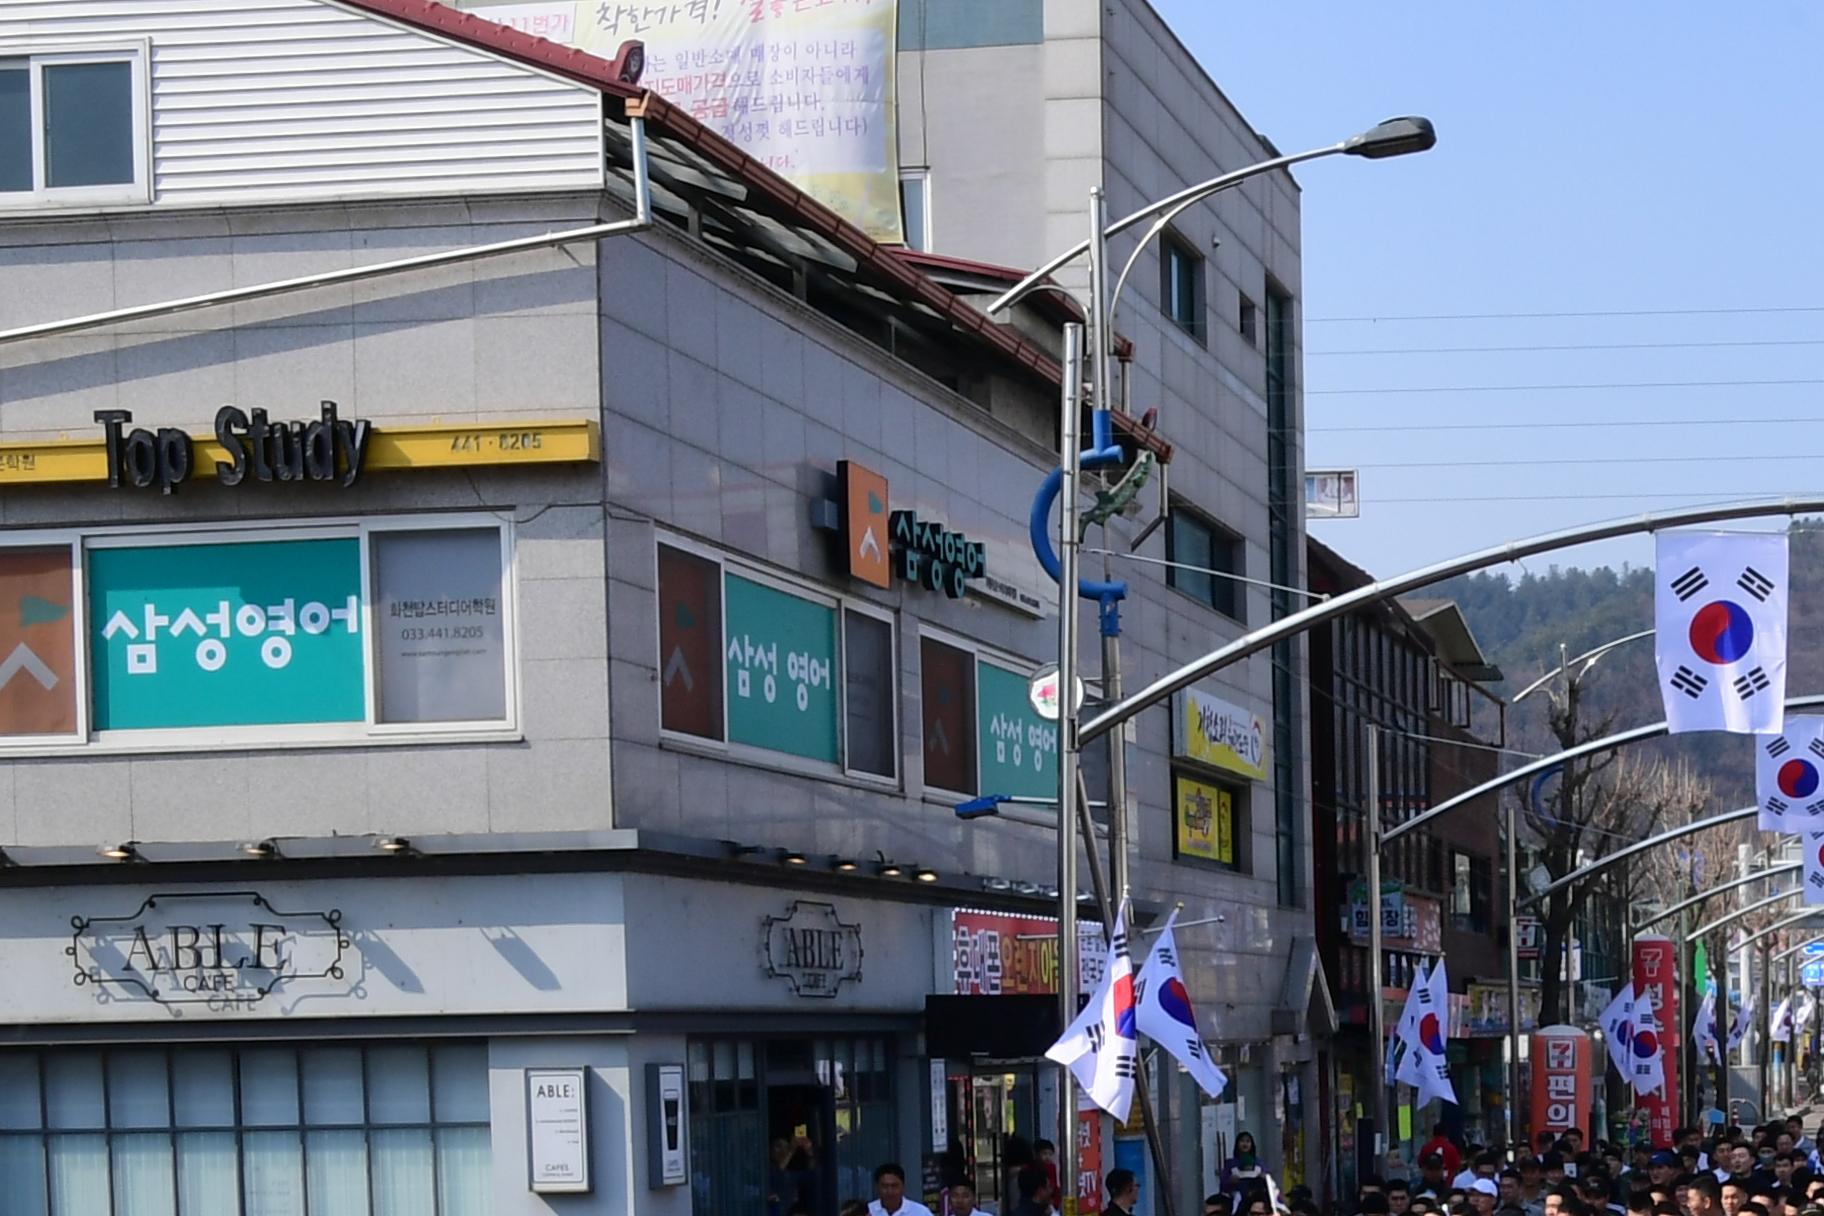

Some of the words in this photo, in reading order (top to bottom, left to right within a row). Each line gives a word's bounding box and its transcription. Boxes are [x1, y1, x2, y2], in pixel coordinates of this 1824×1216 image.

[94, 409, 195, 494] Top
[214, 400, 372, 487] Study
[897, 513, 985, 599] 삼성영어
[102, 596, 358, 675] 삼성영어
[122, 924, 287, 971] ABLE
[784, 928, 845, 971] ABLE
[184, 974, 235, 992] CAFE
[537, 1084, 570, 1098] ABLE
